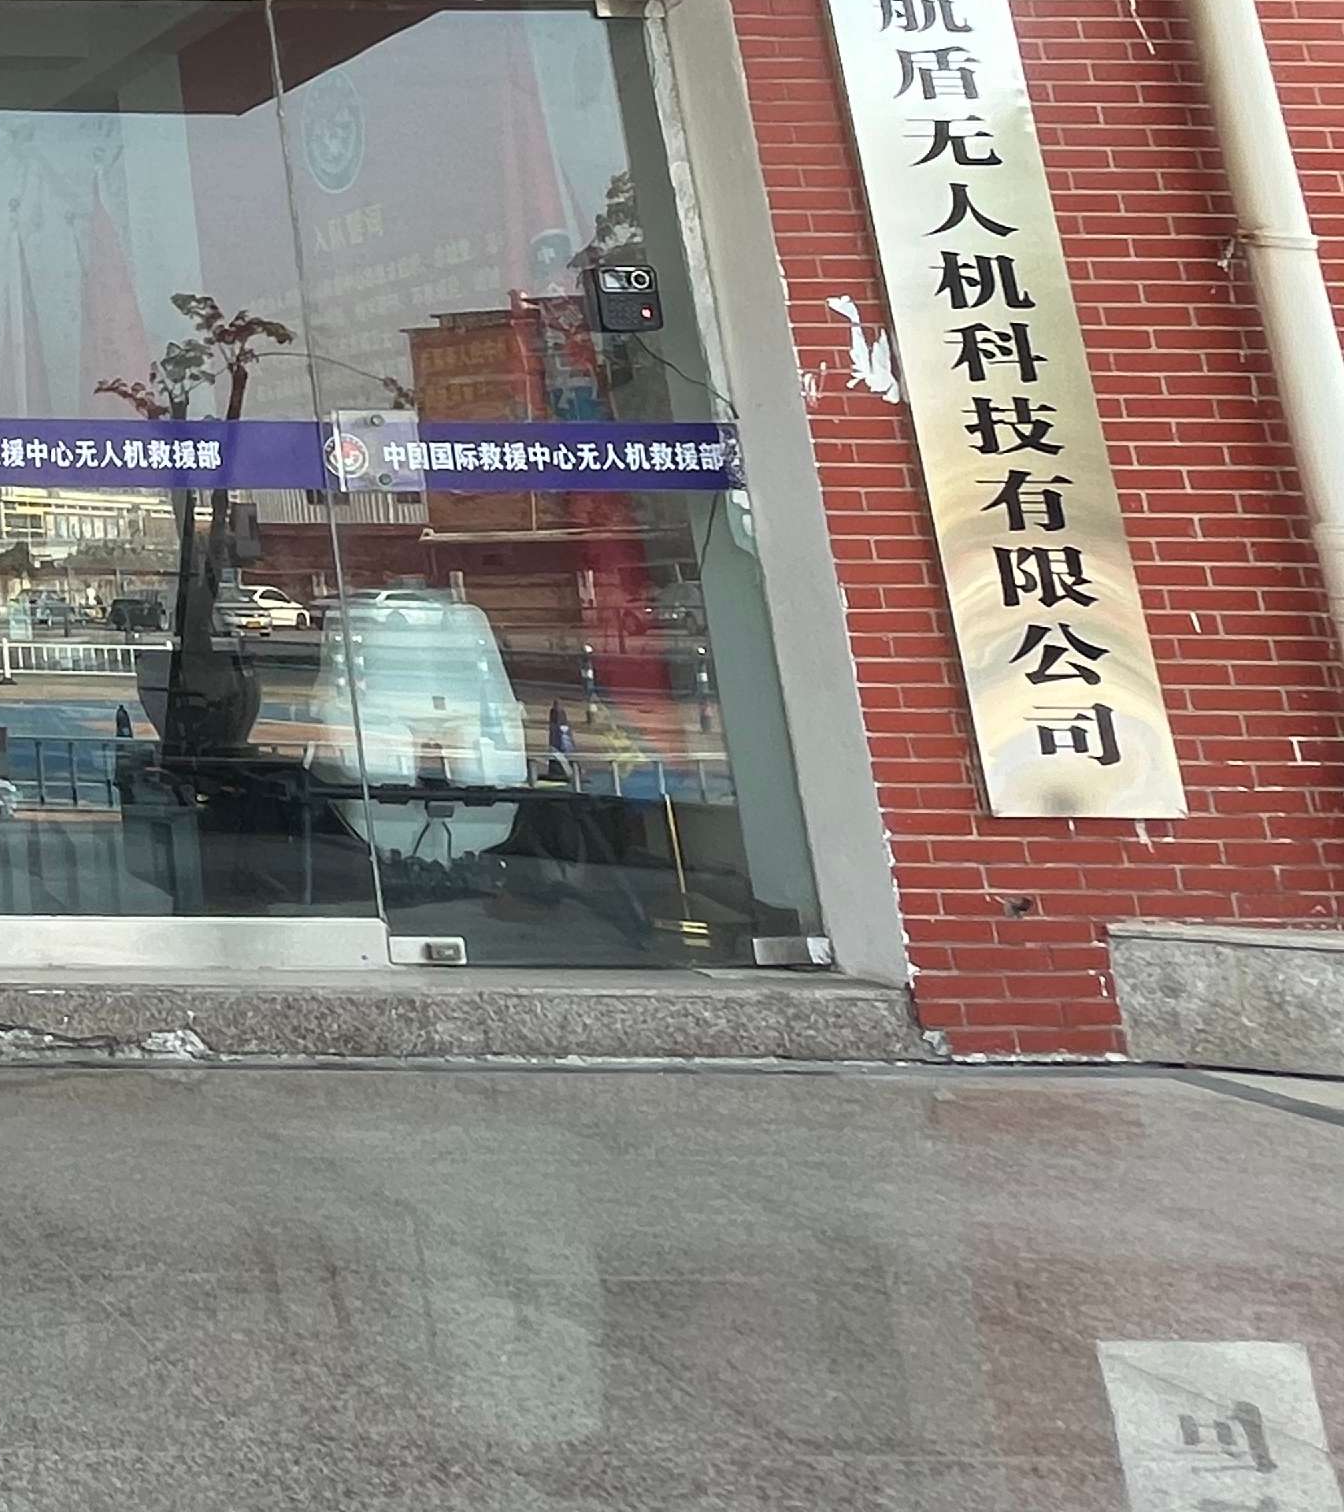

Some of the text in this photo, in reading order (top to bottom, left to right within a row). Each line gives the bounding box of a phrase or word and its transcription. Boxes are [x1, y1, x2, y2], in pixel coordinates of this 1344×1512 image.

[383, 441, 724, 472] 中国国际救援中心无人机救援部
